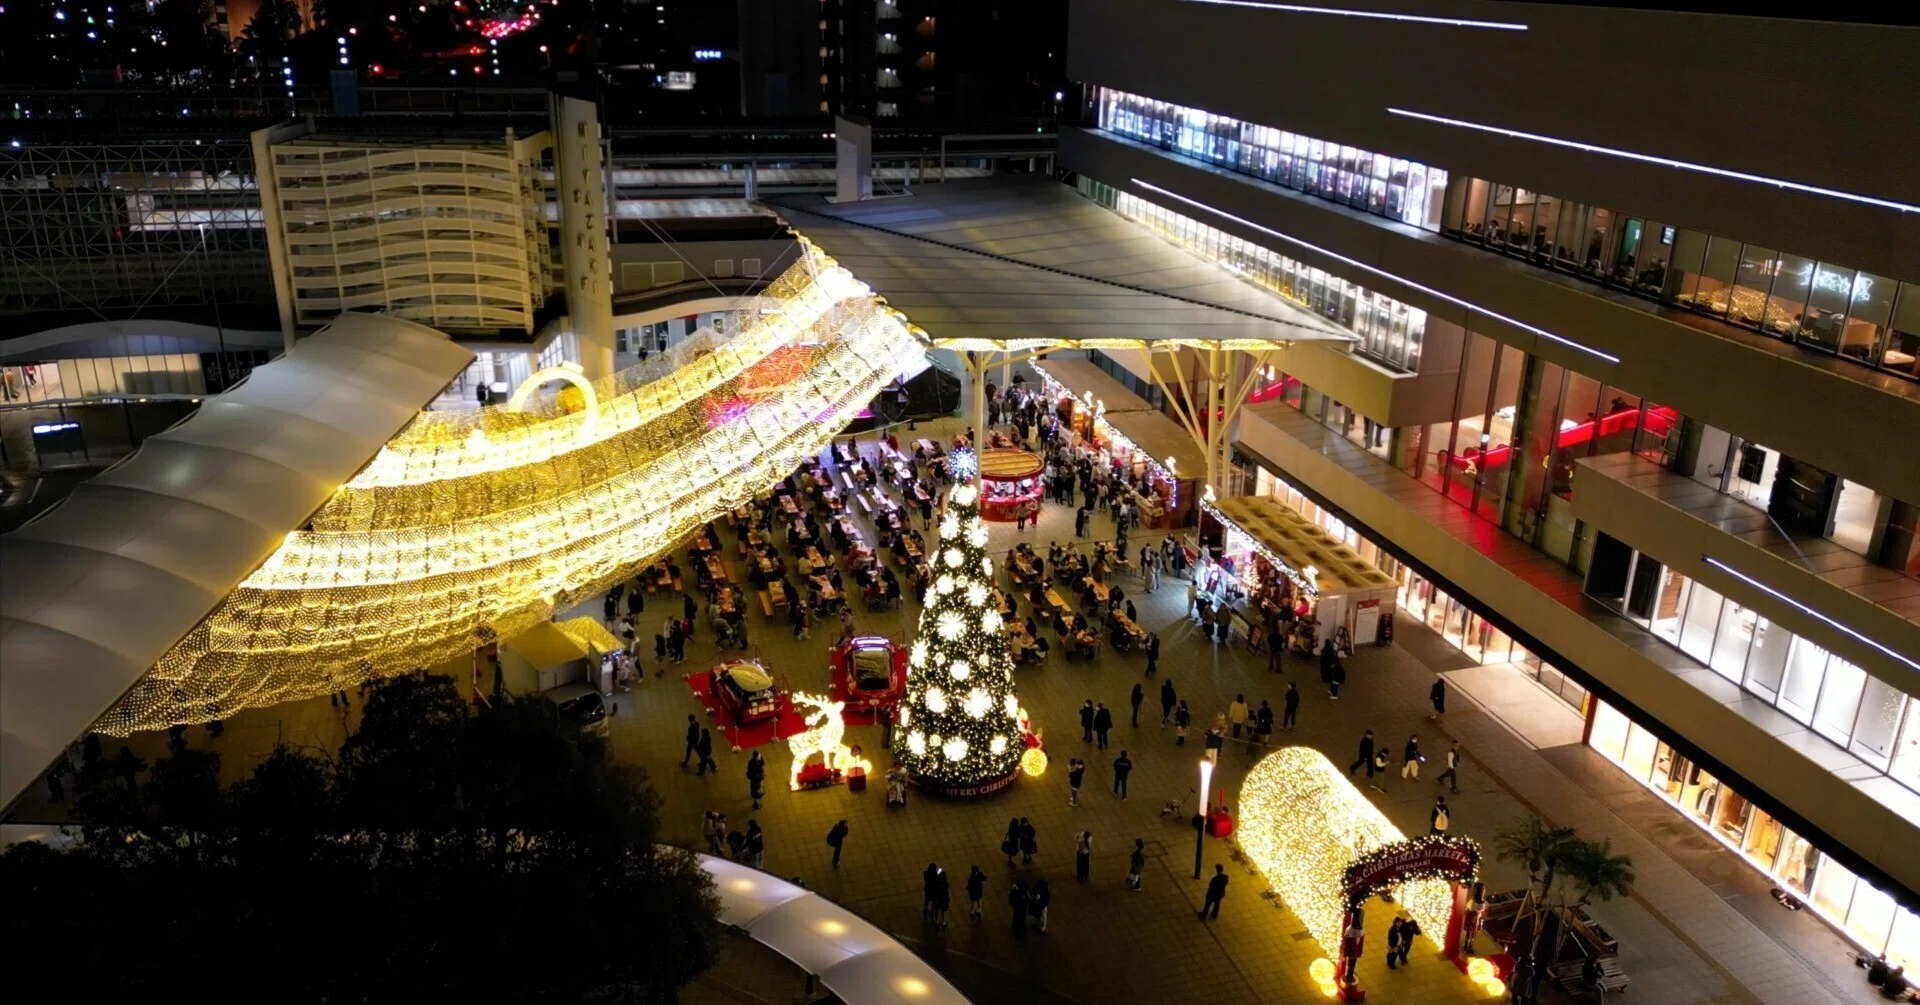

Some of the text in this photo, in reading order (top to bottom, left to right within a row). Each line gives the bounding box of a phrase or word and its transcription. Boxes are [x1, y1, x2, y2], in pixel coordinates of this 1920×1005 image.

[577, 121, 598, 295] MIYAZAKI
[946, 788, 979, 797] MERRY
[1362, 848, 1463, 877] CHRISTMAS MARKET
